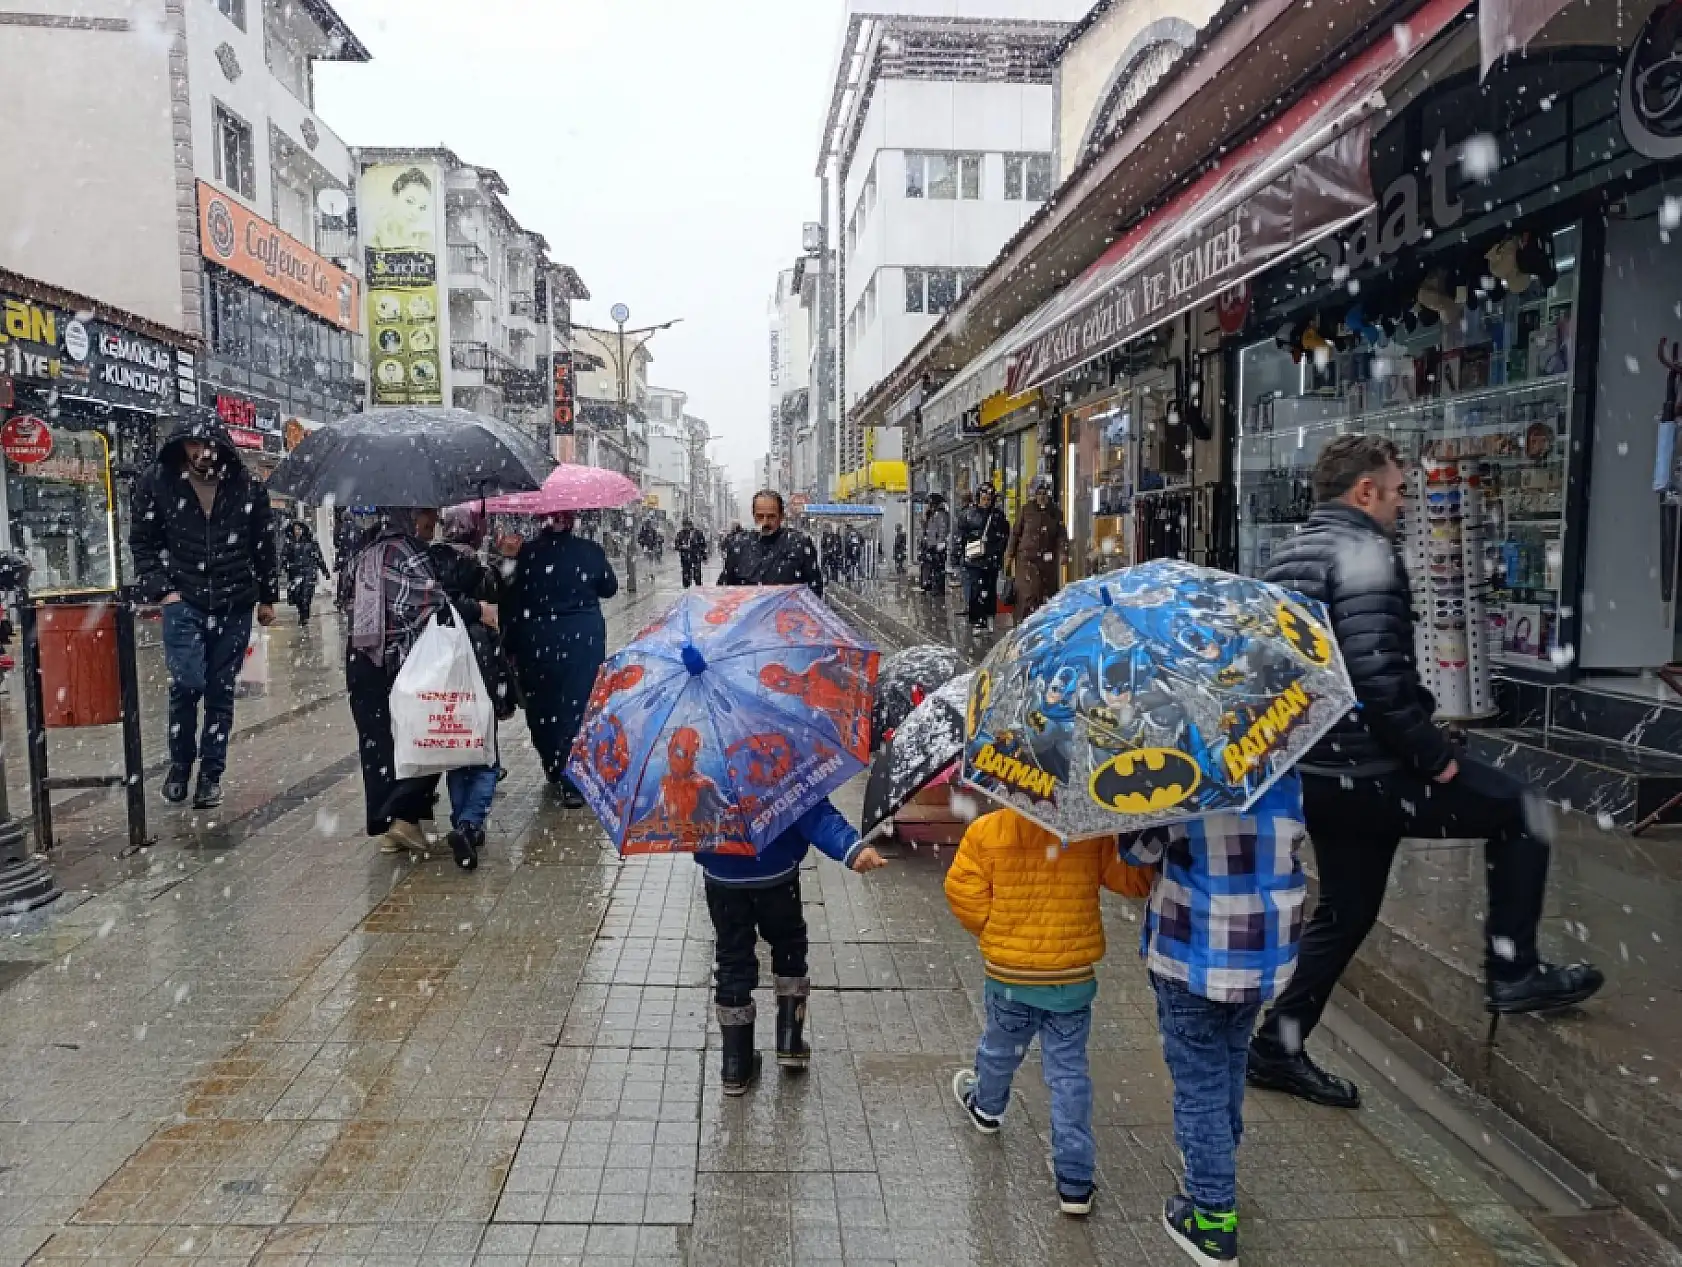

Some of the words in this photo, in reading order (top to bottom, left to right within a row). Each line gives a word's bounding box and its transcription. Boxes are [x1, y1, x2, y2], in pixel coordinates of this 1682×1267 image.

[1141, 270, 1166, 316] VE
[1168, 222, 1242, 301] KEMER
[974, 743, 1058, 798] BATMAN
[1223, 681, 1313, 784] BATMAN
